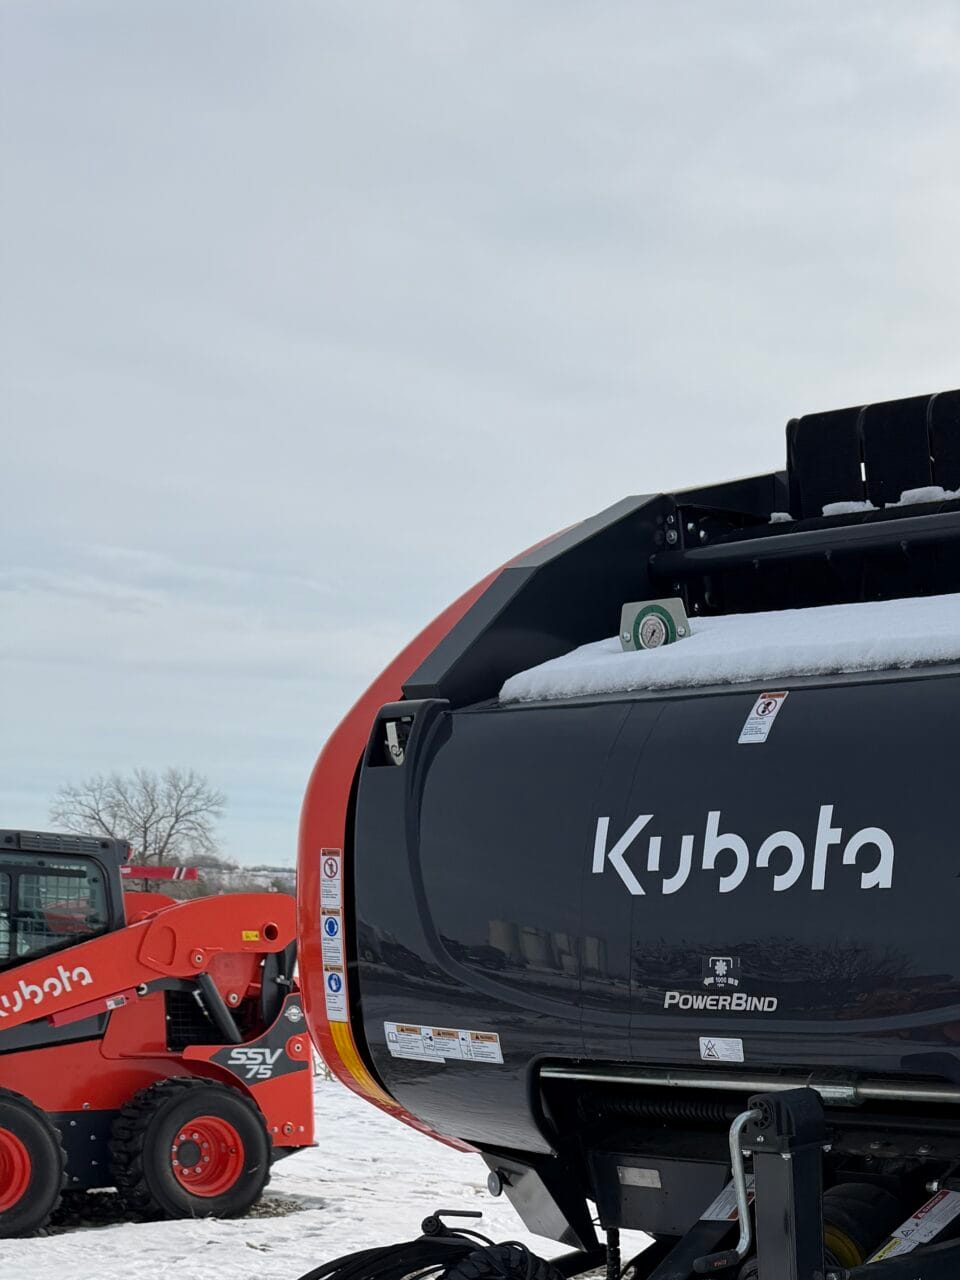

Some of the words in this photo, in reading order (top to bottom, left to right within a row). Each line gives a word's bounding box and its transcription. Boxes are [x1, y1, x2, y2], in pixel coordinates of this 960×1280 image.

[592, 805, 895, 895] Kubota
[227, 1048, 283, 1064] SSV
[245, 1065, 273, 1078] 75
